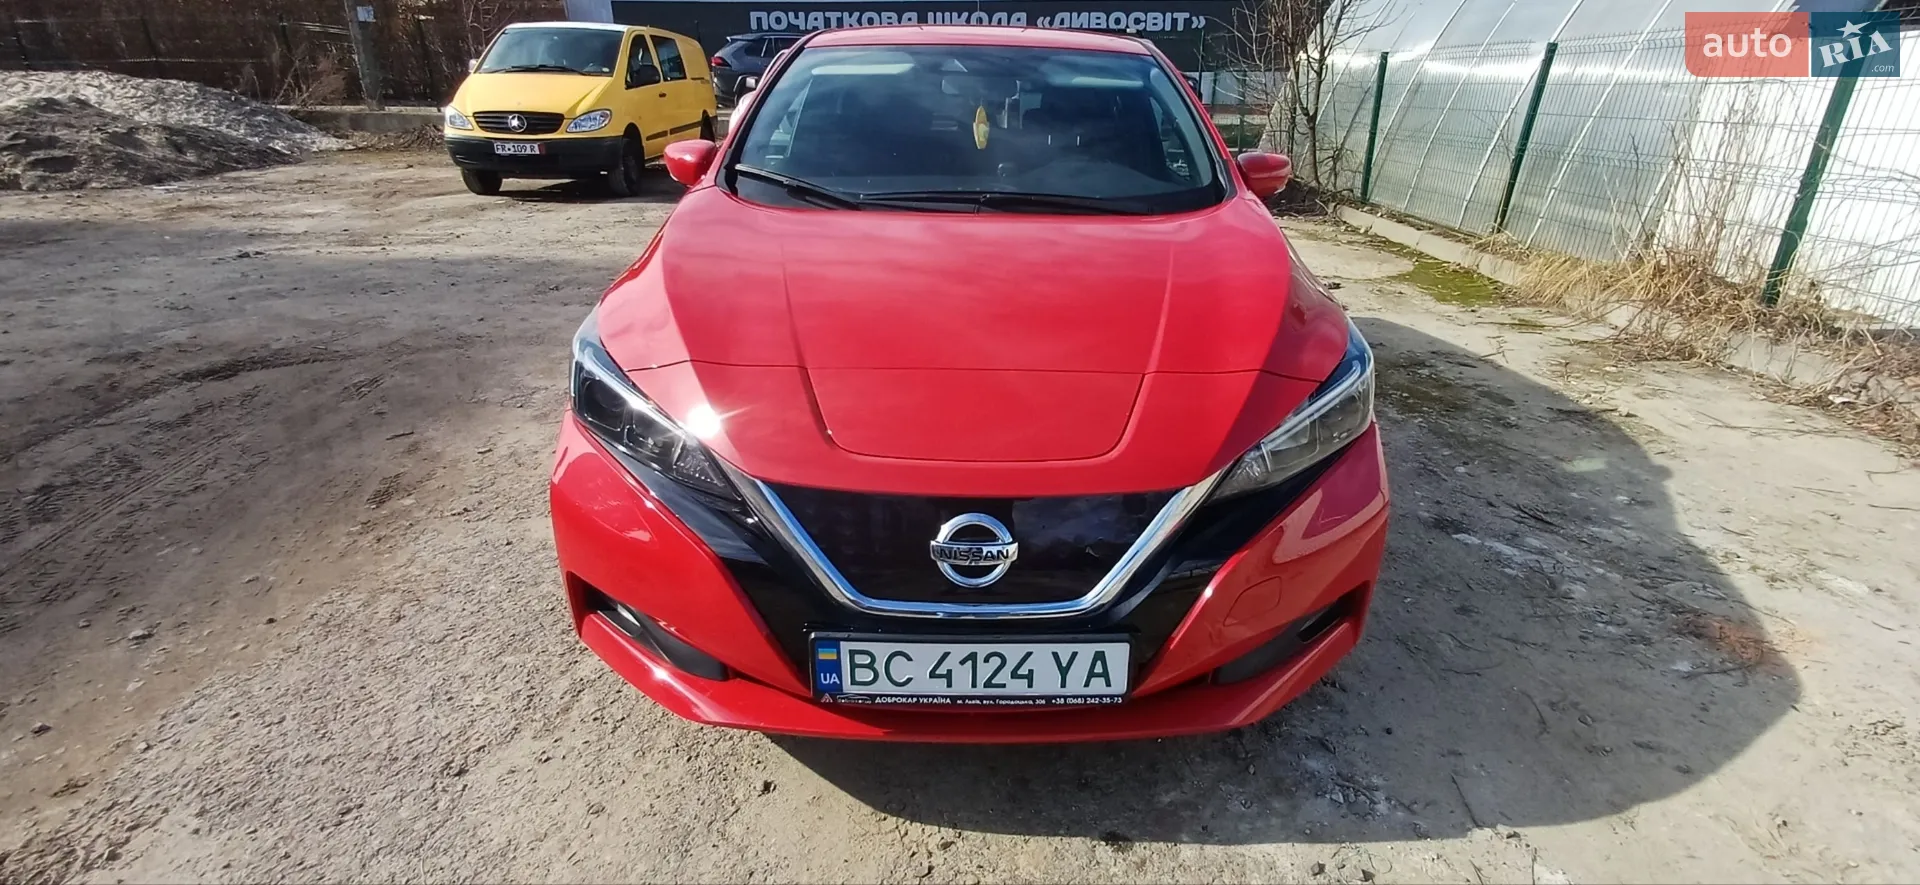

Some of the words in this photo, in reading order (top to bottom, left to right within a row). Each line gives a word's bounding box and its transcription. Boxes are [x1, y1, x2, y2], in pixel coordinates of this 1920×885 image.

[750, 11, 918, 30] ПОЧАТКОВА
[928, 12, 1027, 26] ШКОЛА
[940, 547, 1009, 561] NISSAN
[849, 649, 914, 687] BC
[928, 651, 1034, 688] 4124
[1051, 651, 1112, 688] YA
[820, 673, 840, 685] UA
[875, 696, 917, 704] ДОБРОКАР
[919, 696, 951, 705] УКРАЇНА
